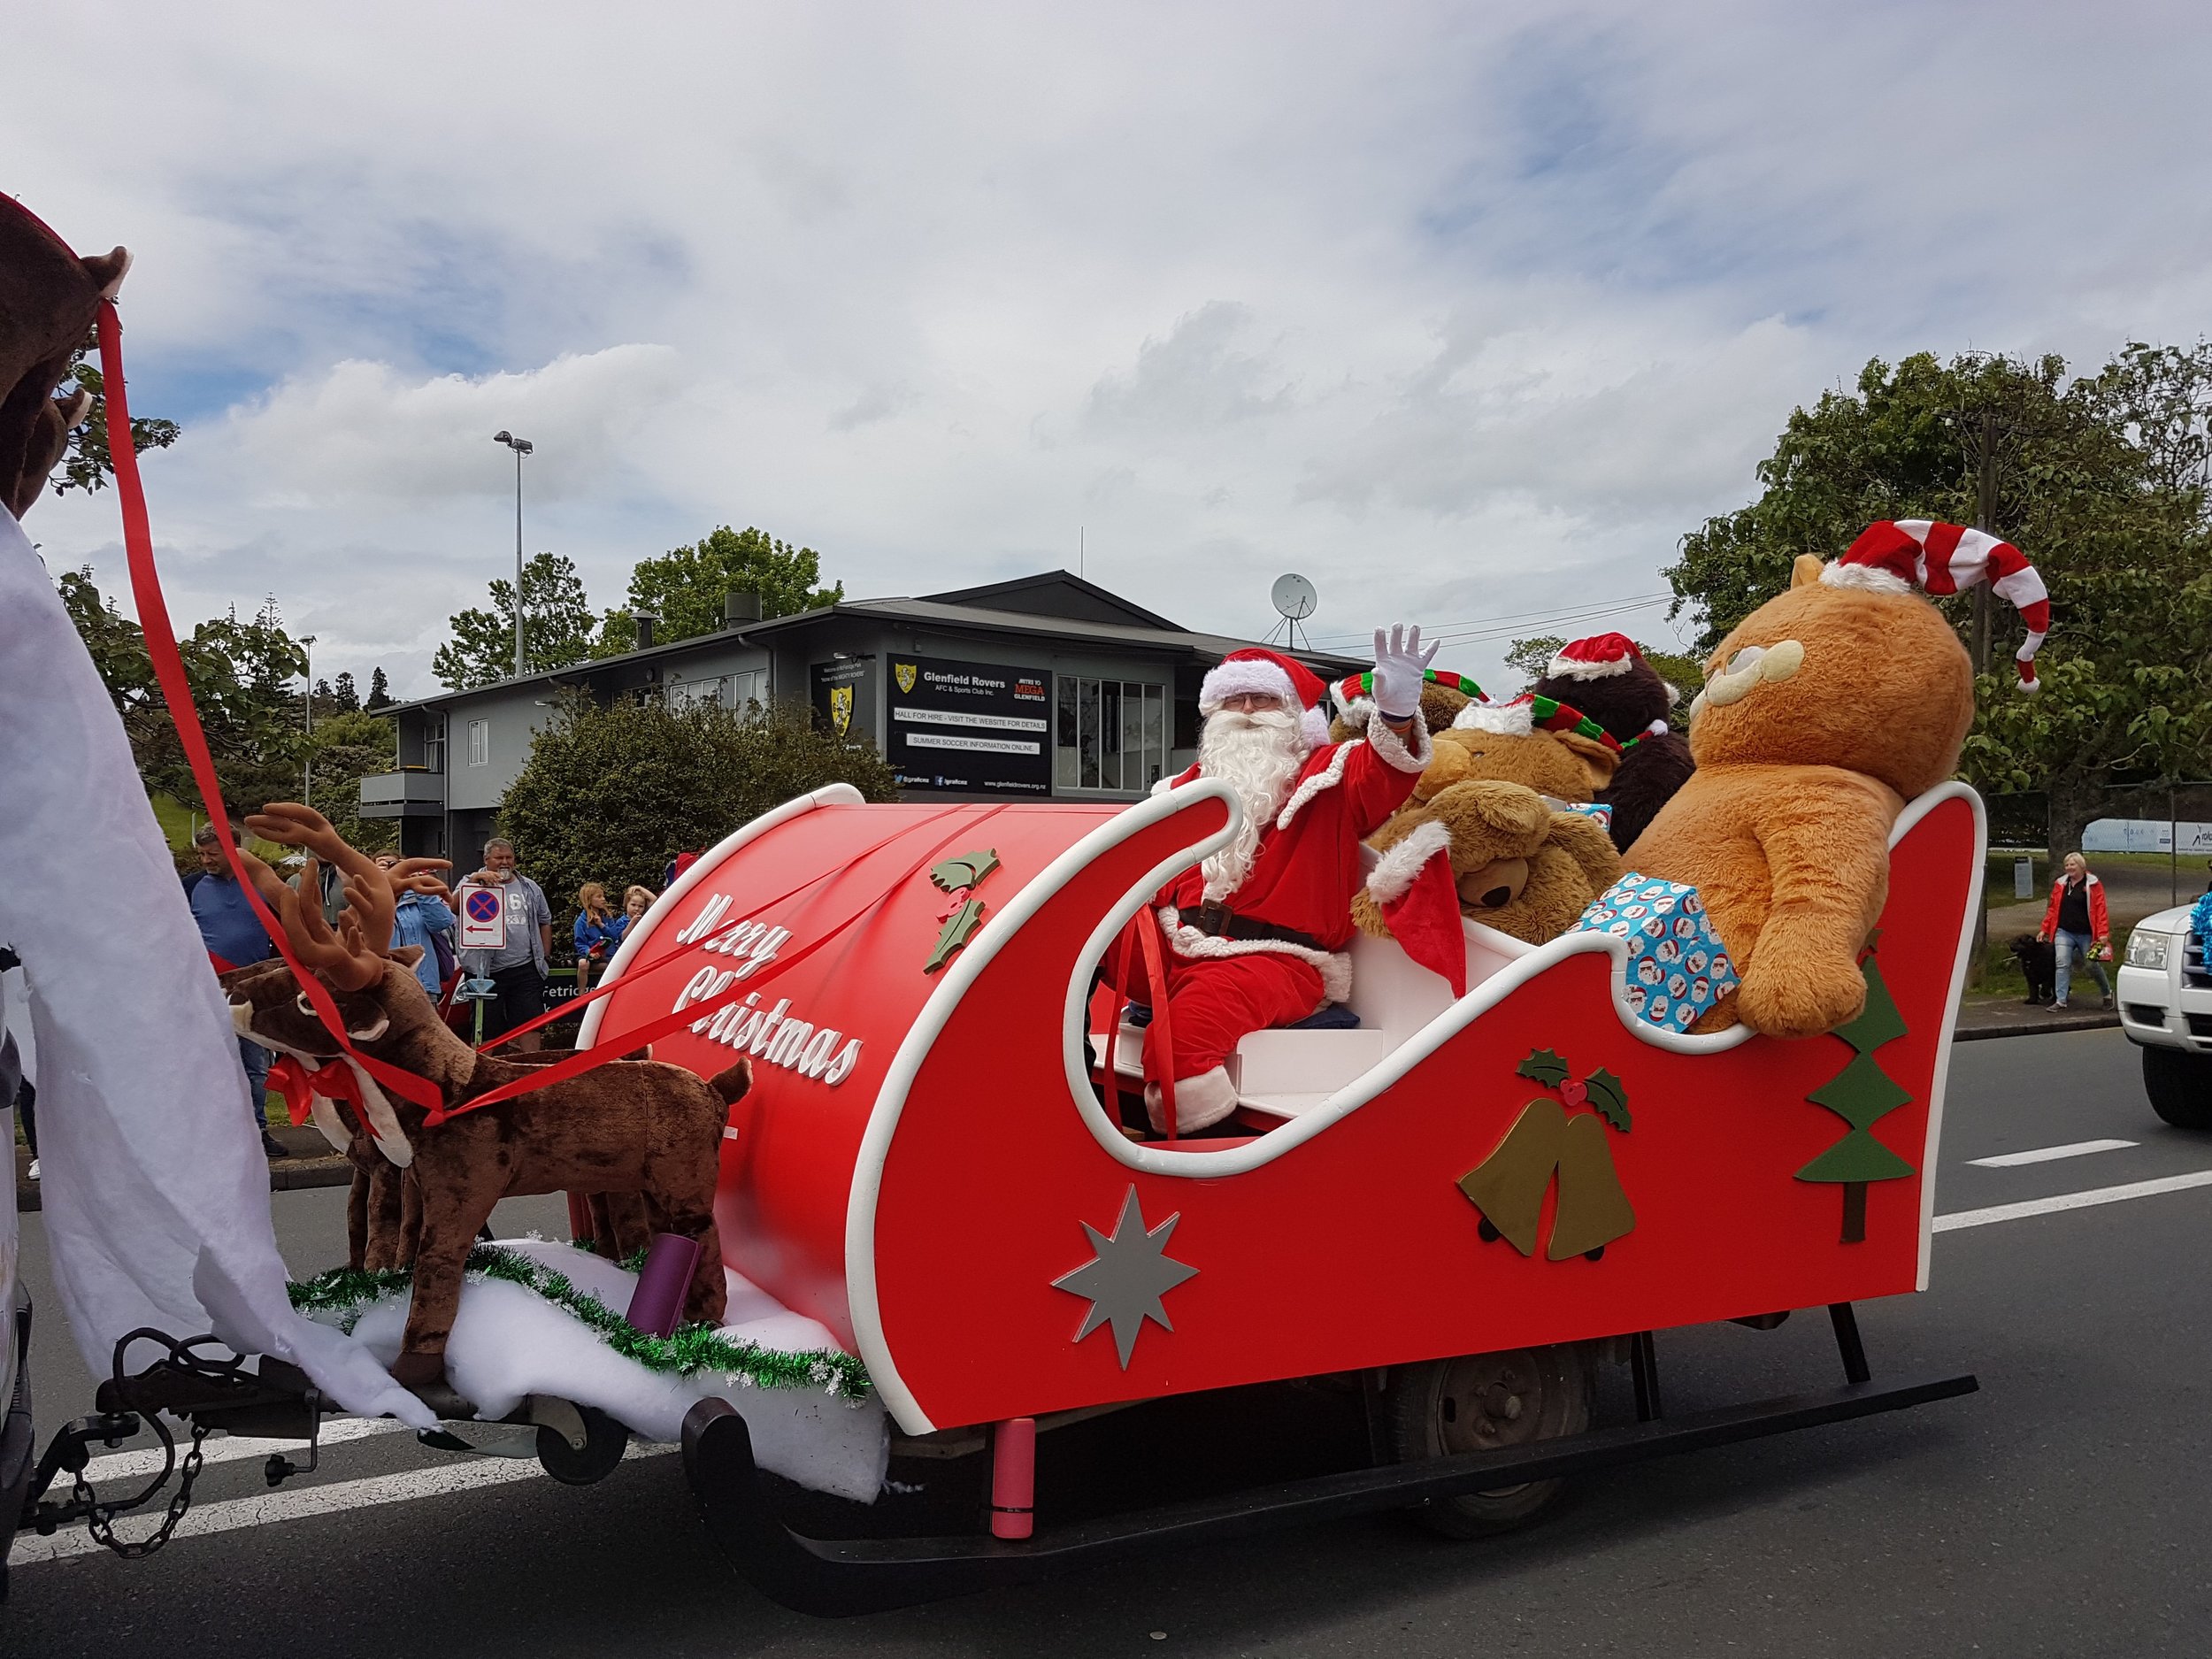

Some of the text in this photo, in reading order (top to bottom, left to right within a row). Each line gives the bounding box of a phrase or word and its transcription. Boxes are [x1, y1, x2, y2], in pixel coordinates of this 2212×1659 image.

[924, 672, 969, 685] Glenfield
[972, 676, 1005, 688] Rovers
[1015, 684, 1044, 695] MEGA
[979, 718, 1007, 726] WEBSITE
[1021, 721, 1045, 730] DETAILS
[970, 741, 1010, 750] INFORMATION
[676, 893, 793, 981] Merry
[672, 965, 864, 1087] Christmas
